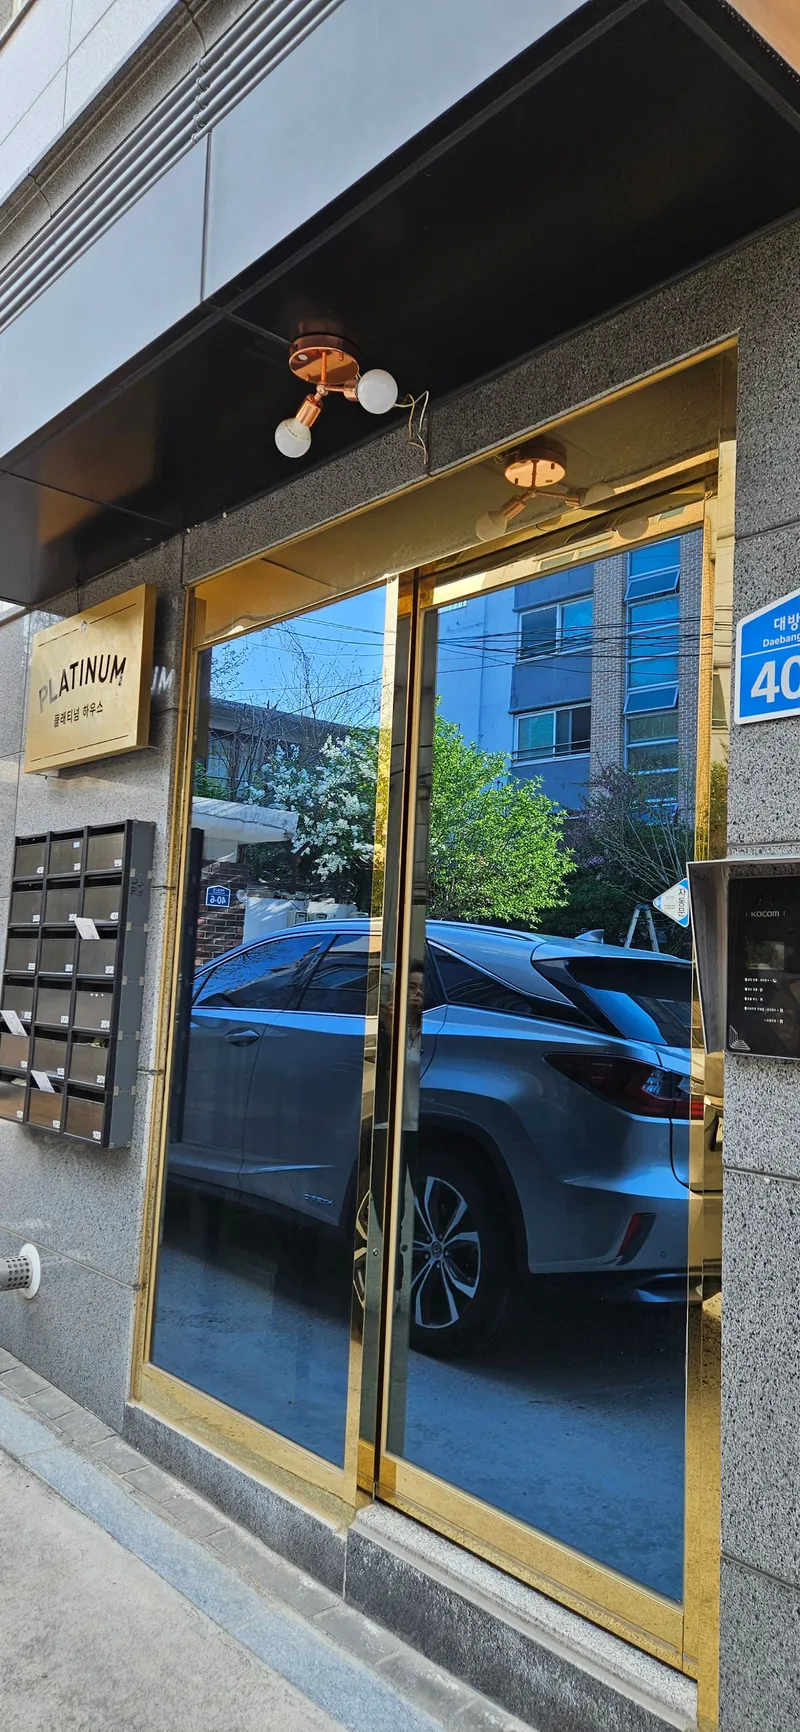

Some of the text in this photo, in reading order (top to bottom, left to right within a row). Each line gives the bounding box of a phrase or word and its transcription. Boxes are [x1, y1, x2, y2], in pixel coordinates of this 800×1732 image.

[38, 654, 127, 713] PLATINUM
[53, 700, 103, 728] 플래티넘 하우스
[678, 888, 686, 917] 자동문
